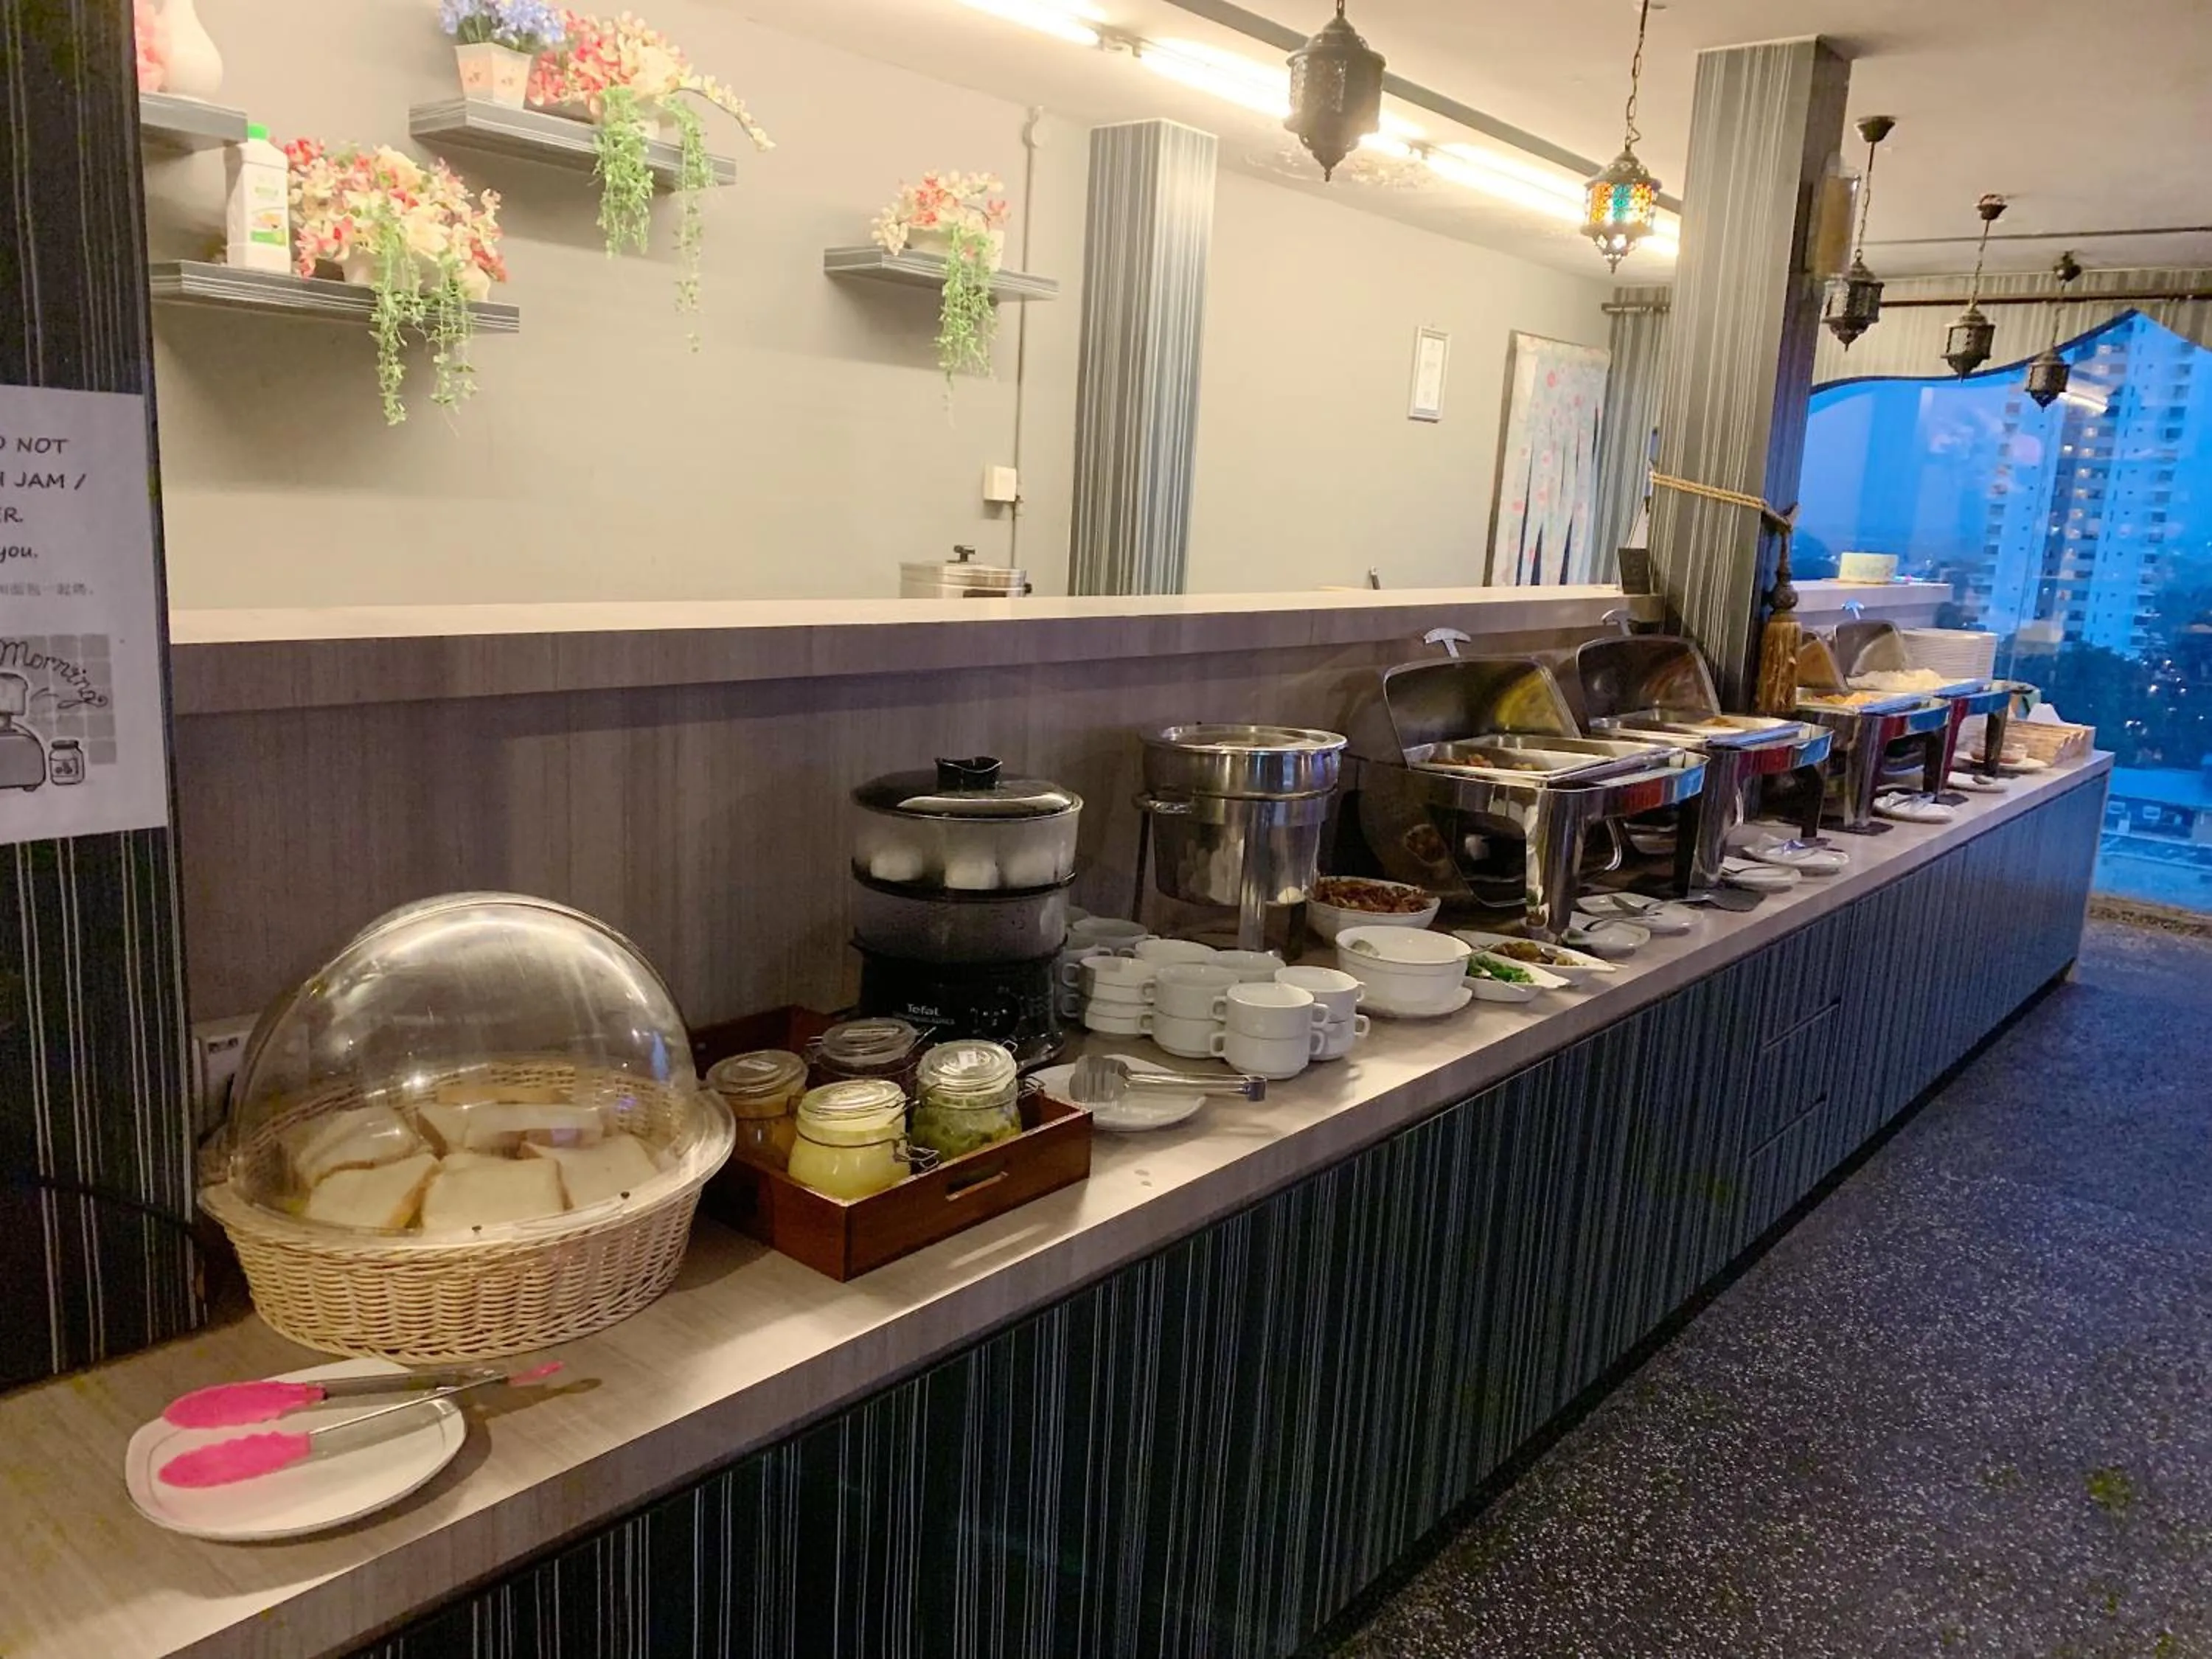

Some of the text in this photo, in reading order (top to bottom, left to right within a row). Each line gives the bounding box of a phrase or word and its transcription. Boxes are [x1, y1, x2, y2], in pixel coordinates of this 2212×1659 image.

[17, 437, 70, 454] NOT
[14, 472, 65, 489] JAM
[0, 546, 38, 564] you.
[907, 1004, 941, 1017] Tefal
